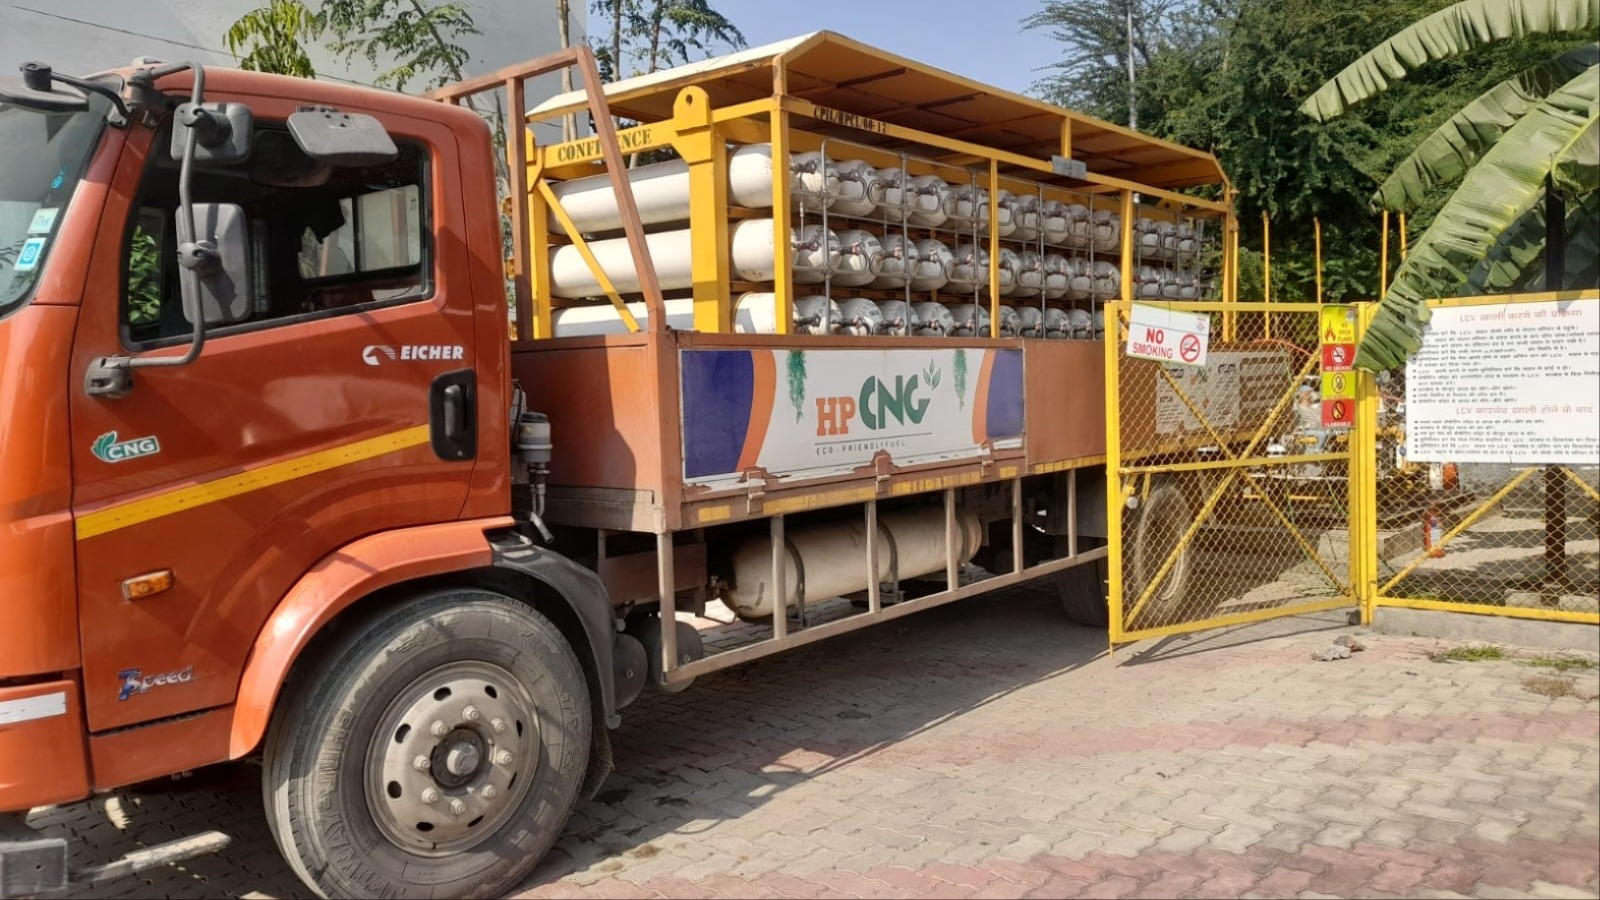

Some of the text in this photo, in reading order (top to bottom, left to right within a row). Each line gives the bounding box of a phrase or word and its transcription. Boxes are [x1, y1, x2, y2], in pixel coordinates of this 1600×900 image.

[558, 128, 652, 162] CONFINCE
[1146, 327, 1164, 344] NO
[400, 345, 464, 360] EICHER
[1132, 342, 1173, 359] SMOKING
[816, 374, 931, 436] HP CNG
[1456, 406, 1473, 415] LCV
[108, 439, 155, 459] CNG
